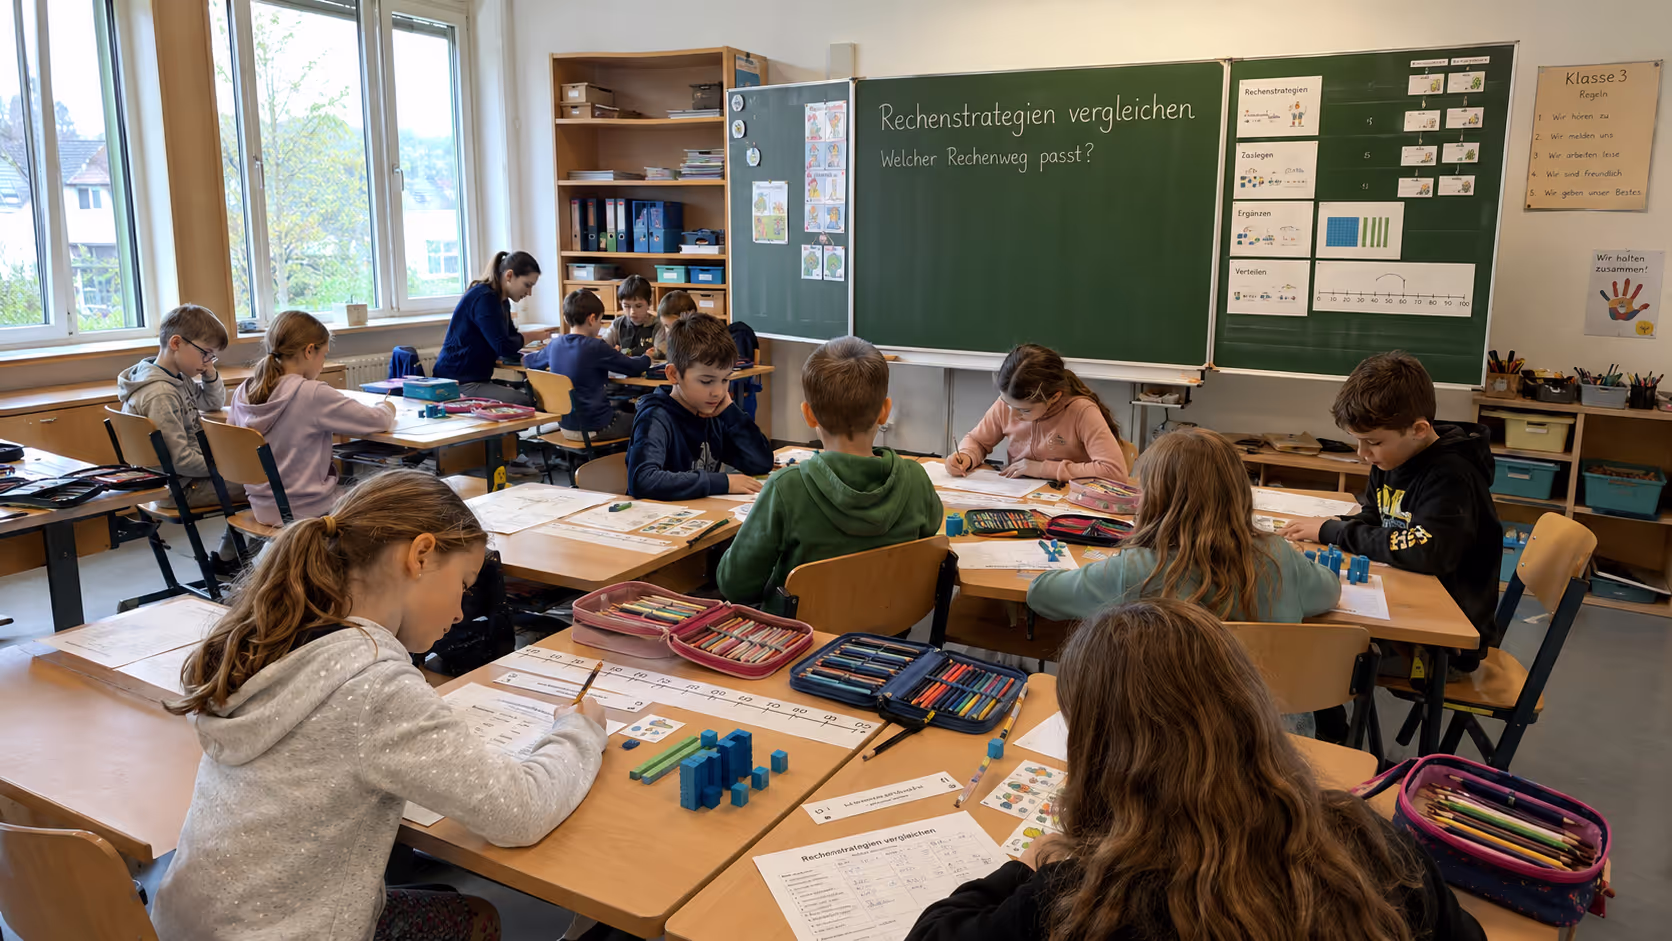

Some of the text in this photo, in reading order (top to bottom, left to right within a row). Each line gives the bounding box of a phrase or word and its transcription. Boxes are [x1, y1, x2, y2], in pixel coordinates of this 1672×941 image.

[1565, 69, 1628, 86] Klasse 3
[1244, 86, 1308, 96] Rechenstrategien
[1579, 89, 1608, 101] Regeln
[878, 93, 1196, 137] Rechenstrategien vergleichen
[1552, 113, 1567, 121] Wir
[1571, 112, 1594, 120] hören
[1568, 132, 1596, 140] melden
[880, 142, 1094, 174] Welcher Rechenweg passt?
[1566, 151, 1598, 159] arbeiten
[1602, 150, 1620, 158] leise
[1546, 170, 1560, 178] Wir
[1584, 169, 1623, 177] freundlich
[1544, 188, 1558, 196] Wir
[1561, 189, 1584, 199] geben
[1237, 209, 1272, 219] Ergänzen
[1596, 254, 1613, 262] Wir
[1235, 267, 1267, 276] Verteilen
[1595, 266, 1648, 274] zusammen!
